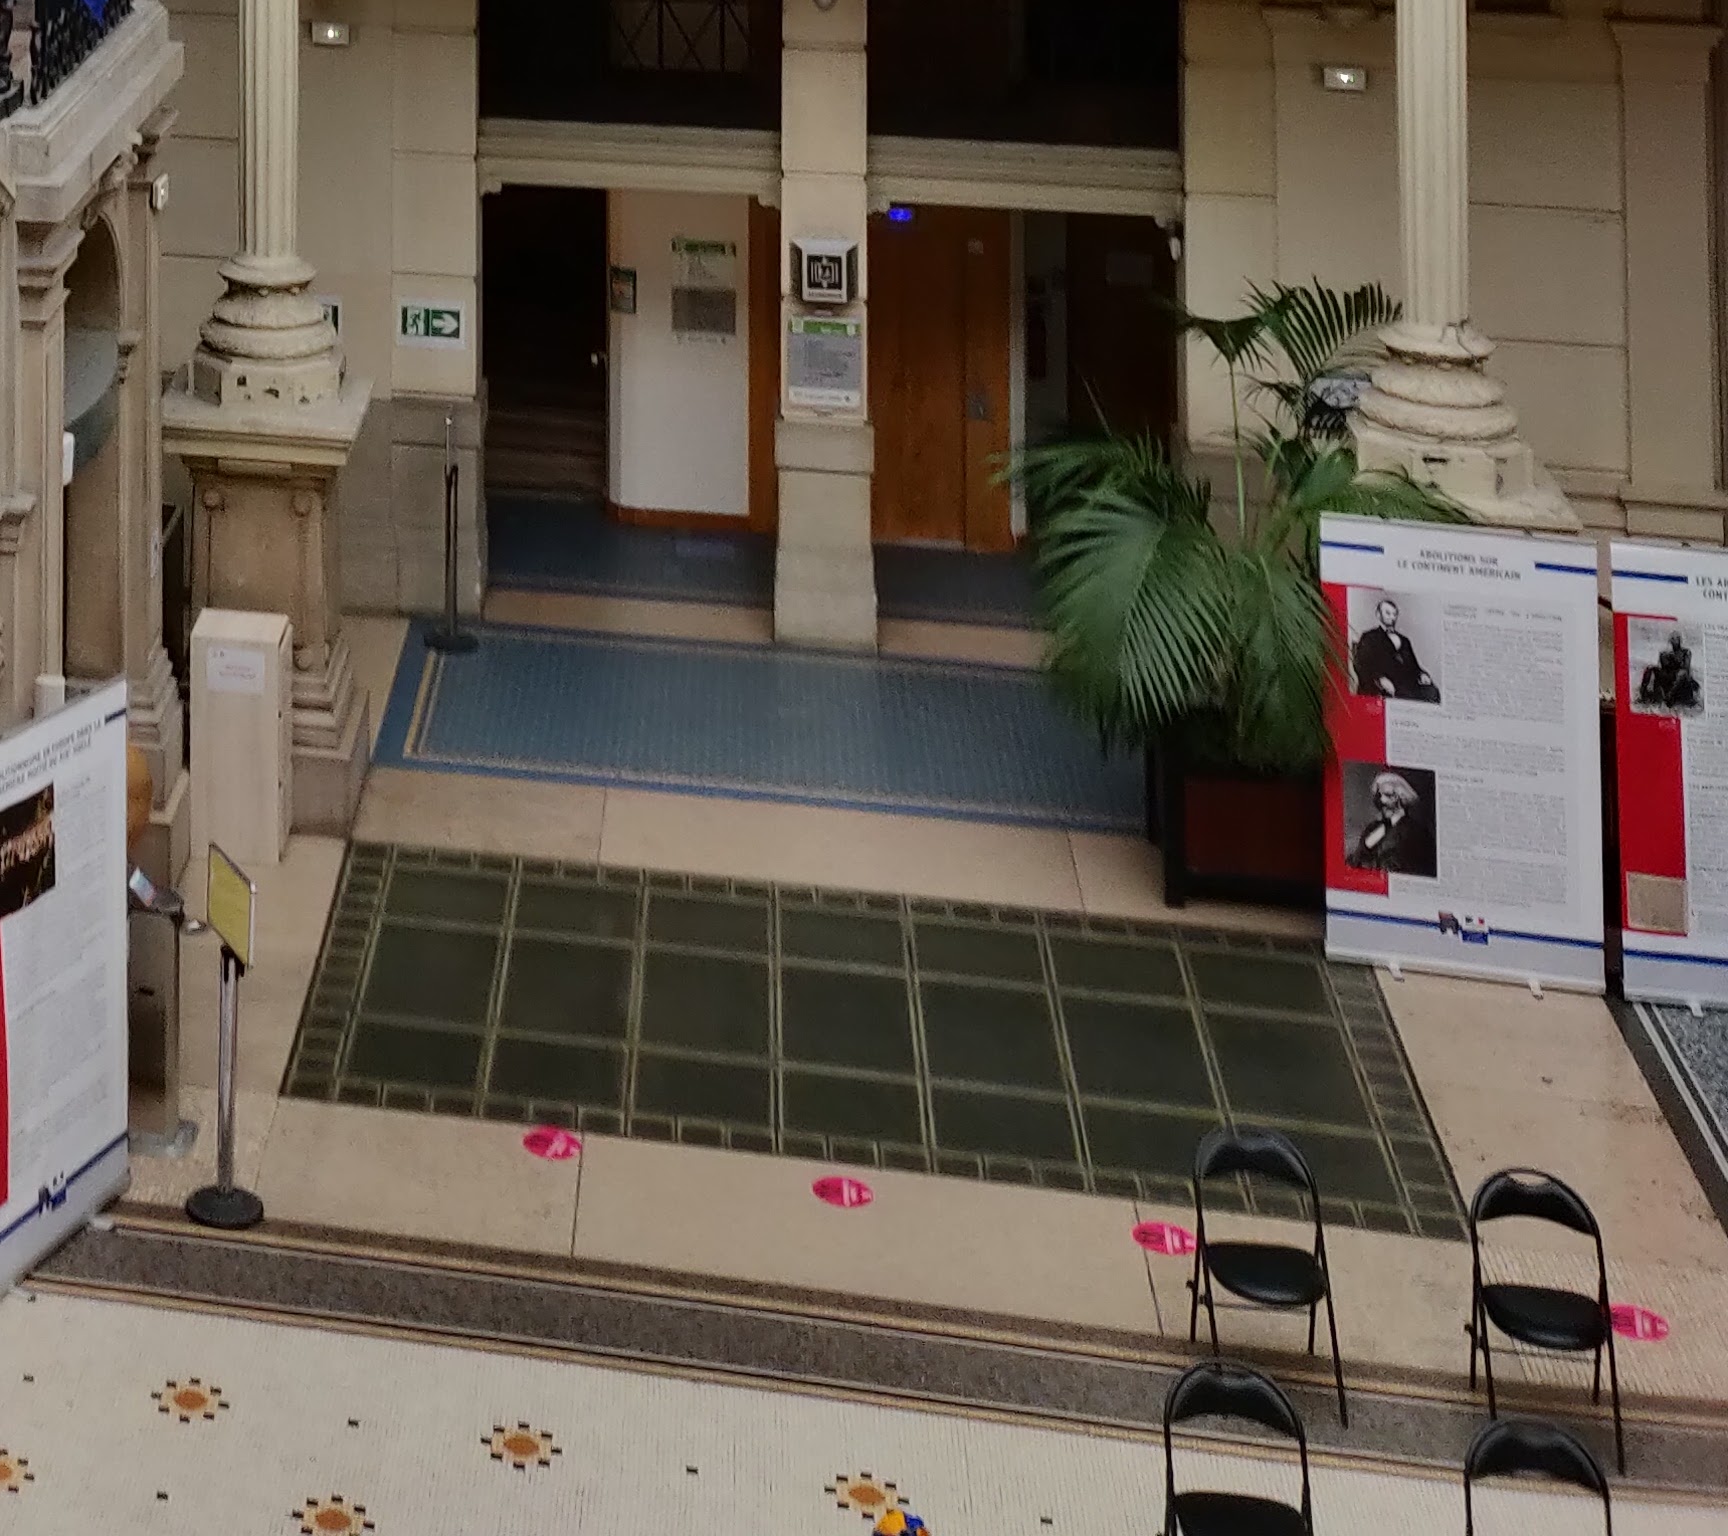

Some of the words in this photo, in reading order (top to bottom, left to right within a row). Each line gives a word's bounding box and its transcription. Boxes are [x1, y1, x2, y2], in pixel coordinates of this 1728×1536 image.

[1419, 548, 1476, 563] ABOLITIONS
[1479, 555, 1498, 566] SUR
[1397, 559, 1408, 569] LE
[1412, 561, 1465, 575] CONTINENT
